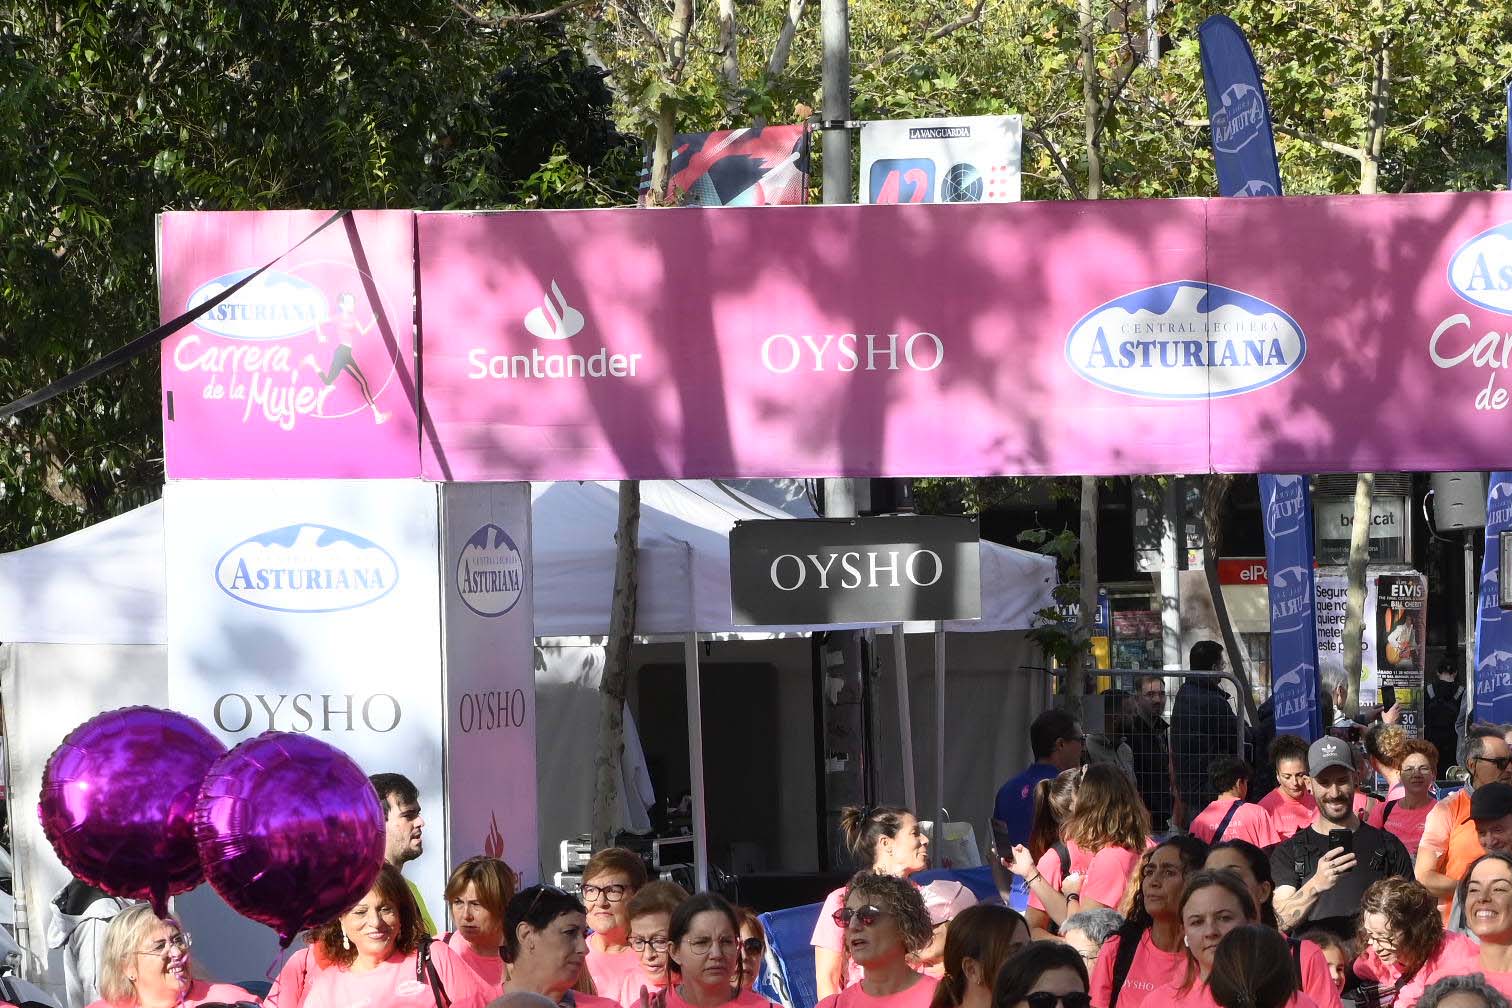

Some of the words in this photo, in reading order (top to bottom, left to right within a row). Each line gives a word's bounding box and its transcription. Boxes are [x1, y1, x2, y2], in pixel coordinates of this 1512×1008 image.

[910, 129, 922, 138] LA
[921, 127, 970, 138] VANGUARDIA
[1121, 322, 1196, 334] CENTRAL
[1204, 320, 1279, 332] LECHERA
[174, 335, 291, 372] Carrera
[468, 346, 641, 379] Santander
[761, 332, 945, 374] OYSHO
[1086, 326, 1288, 369] ASTURIANA
[203, 375, 224, 400] de
[230, 374, 245, 400] la
[243, 371, 336, 431] Mujer
[1475, 373, 1510, 411] de
[230, 557, 385, 591] ASTURIANA
[462, 559, 520, 594] ASTURIANA
[769, 549, 943, 592] OYSHO
[1316, 603, 1332, 613] que
[1391, 584, 1423, 597] ELVIS
[1318, 641, 1337, 651] este
[1338, 641, 1369, 655] po
[213, 692, 403, 733] OYSHO
[459, 688, 526, 733] OYSHO
[1402, 713, 1414, 725] 30
